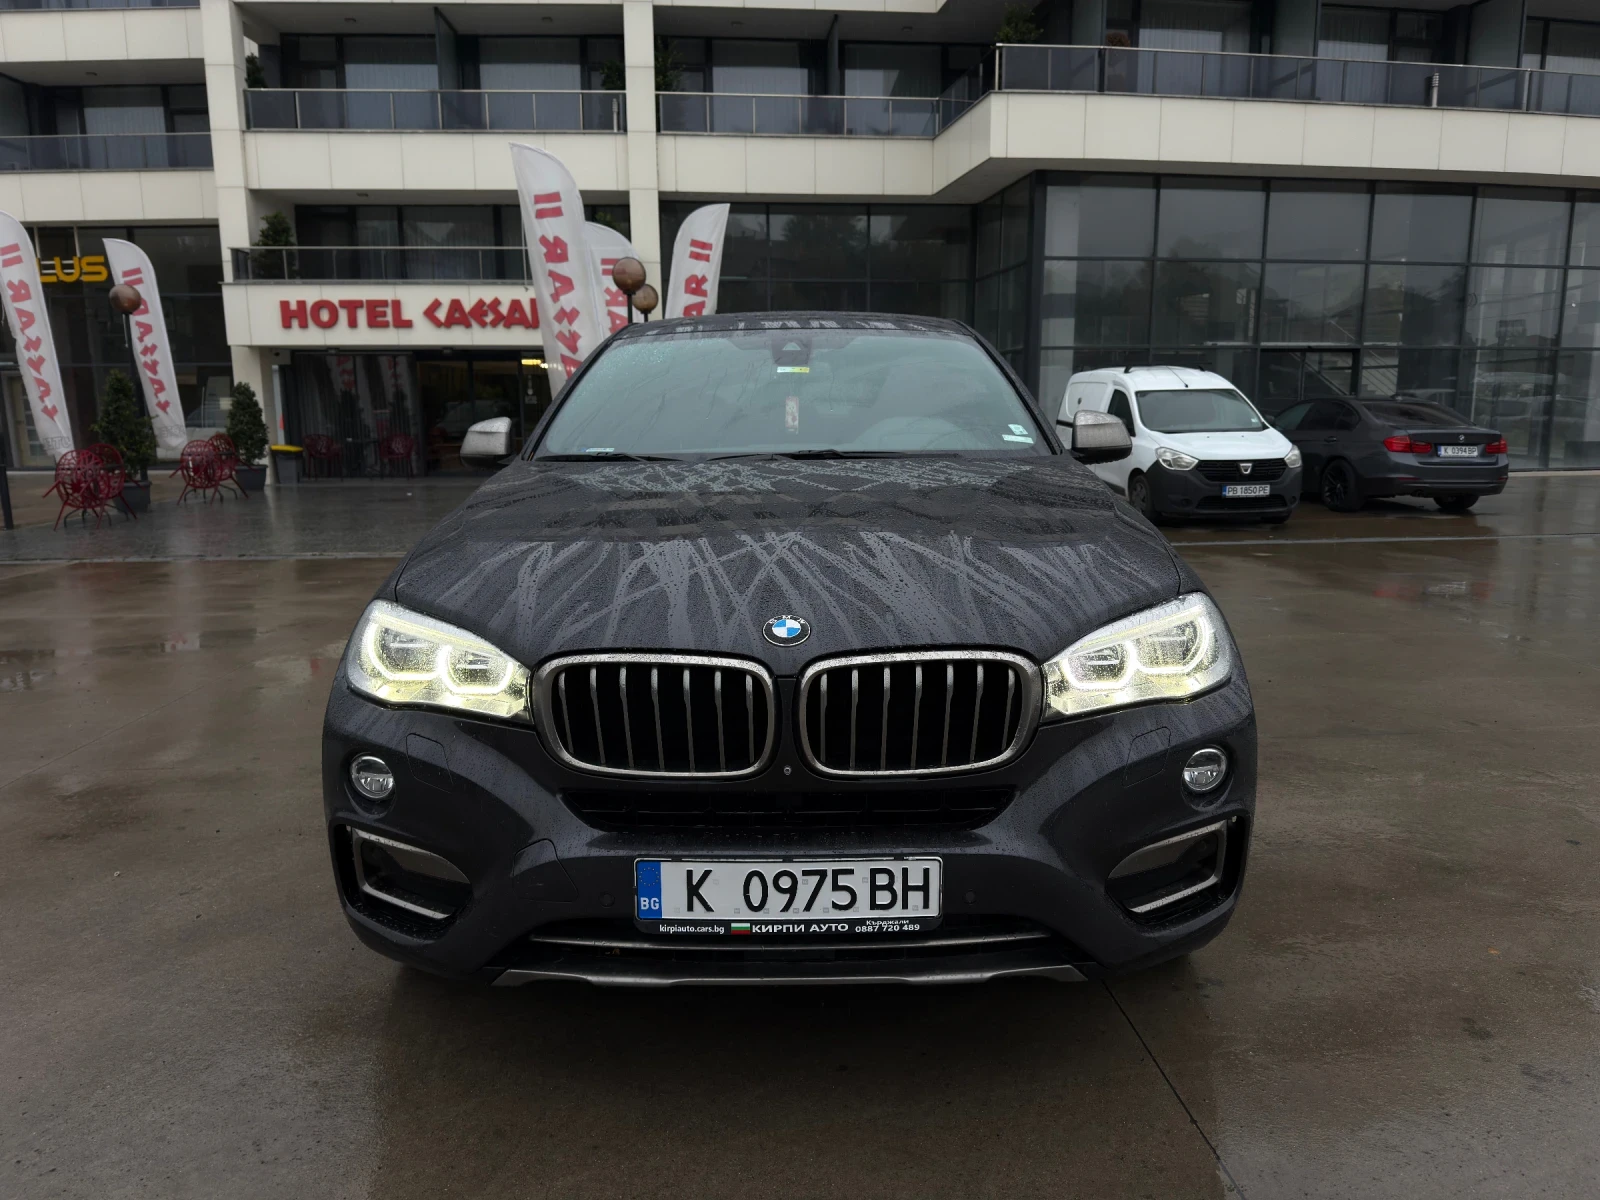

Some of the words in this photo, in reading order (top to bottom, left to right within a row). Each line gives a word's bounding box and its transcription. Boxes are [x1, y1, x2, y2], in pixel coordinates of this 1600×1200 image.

[683, 274, 708, 317] AR
[280, 298, 413, 329] HOTEL
[1240, 486, 1257, 494] 1850
[686, 869, 714, 912] K
[742, 868, 858, 913] 0975
[869, 867, 931, 911] BH
[640, 898, 660, 910] BG
[659, 924, 725, 934] kirpiauto.cars.bg
[752, 924, 805, 933] КИРПИ
[809, 923, 849, 932] АУТО
[855, 925, 879, 933] 0887
[882, 924, 900, 932] 720
